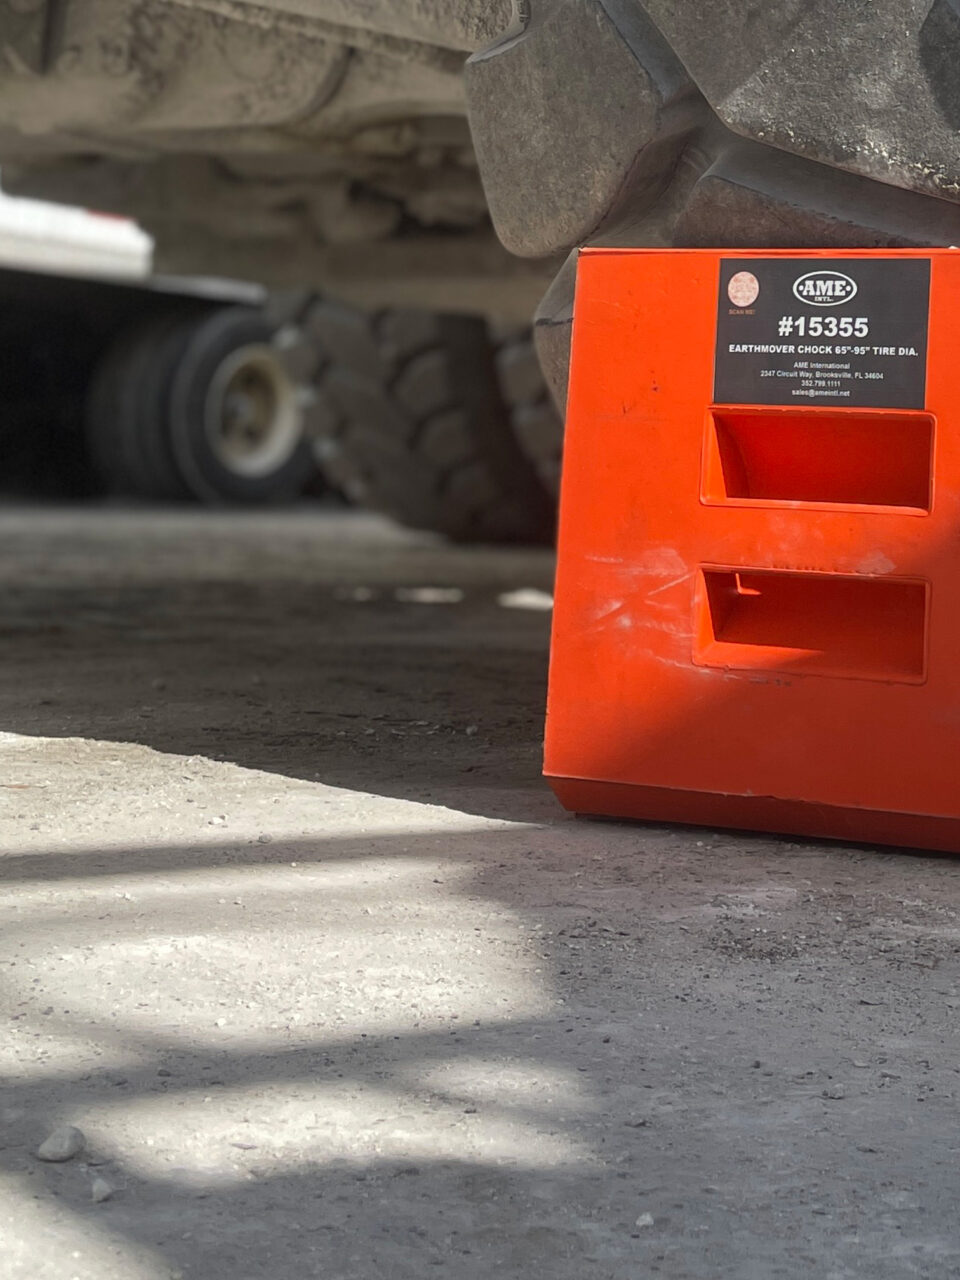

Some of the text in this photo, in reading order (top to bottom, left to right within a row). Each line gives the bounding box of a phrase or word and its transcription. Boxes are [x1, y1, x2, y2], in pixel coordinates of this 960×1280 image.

[802, 280, 847, 296] AME
[778, 316, 869, 338] #15355
[729, 344, 795, 354] EARTHMOVER
[798, 345, 832, 355] CHOCK
[873, 347, 896, 356] TIRE
[898, 347, 918, 357] DIA.
